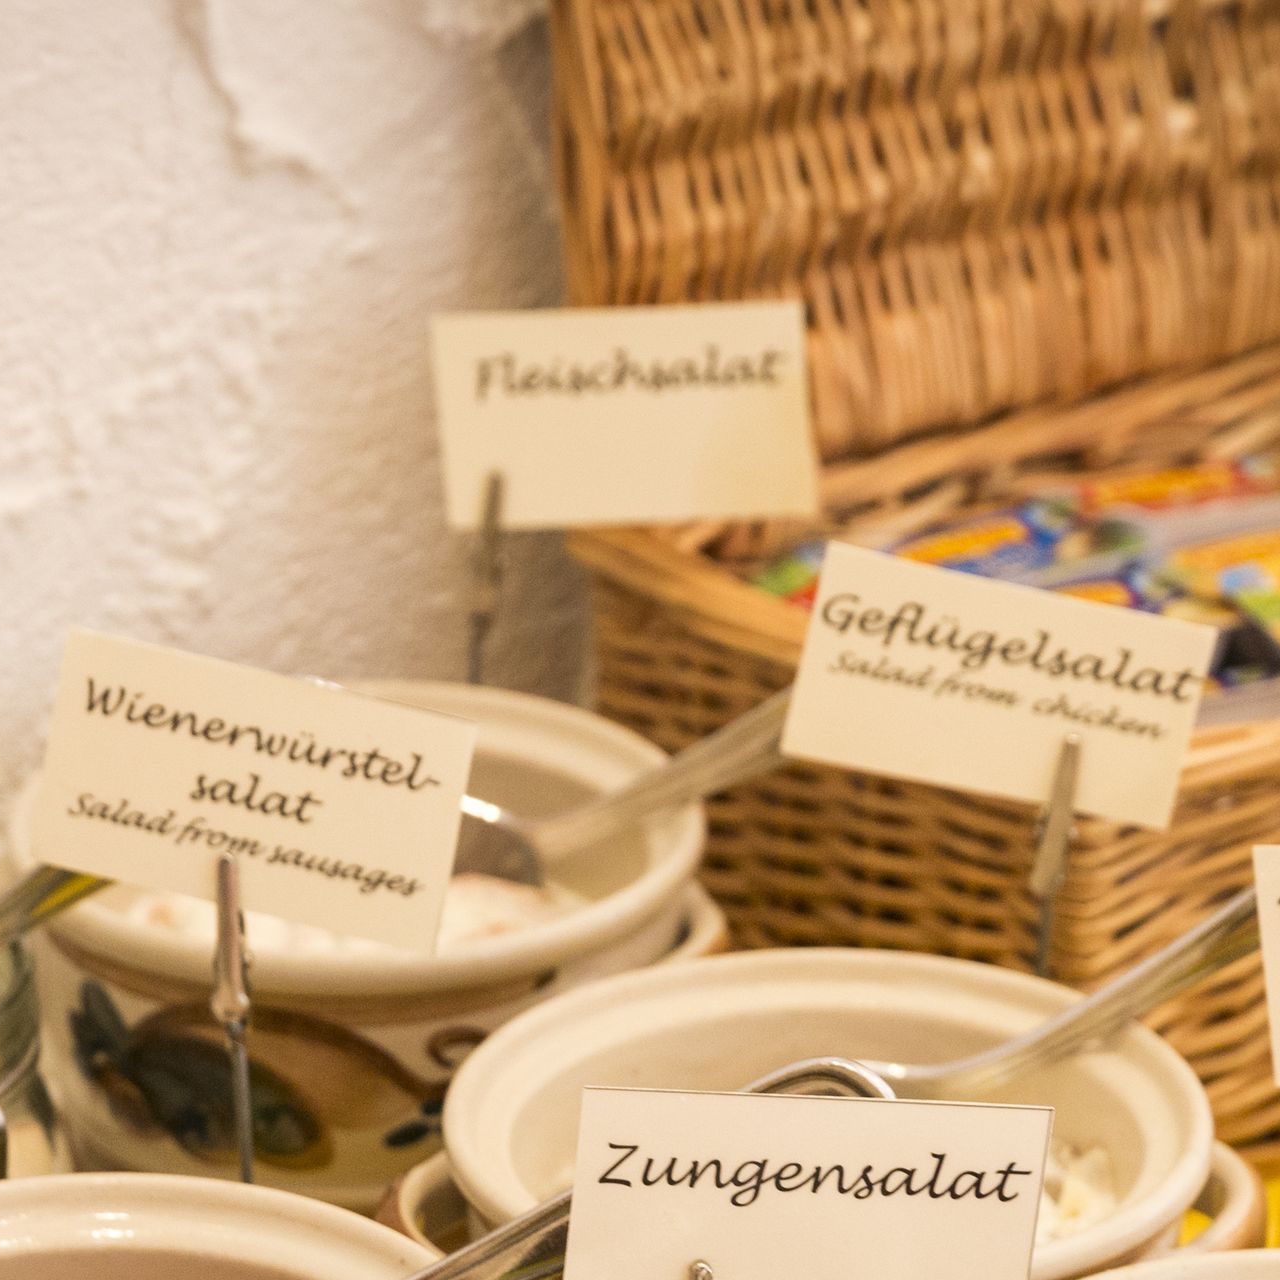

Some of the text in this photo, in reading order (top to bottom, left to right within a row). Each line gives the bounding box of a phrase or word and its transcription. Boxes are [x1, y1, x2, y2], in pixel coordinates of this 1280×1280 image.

[821, 591, 1205, 703] Geflügelsalat
[189, 772, 323, 826] salat
[67, 792, 422, 896] Salad from sausages
[597, 1141, 1033, 1208] Zungensalat
